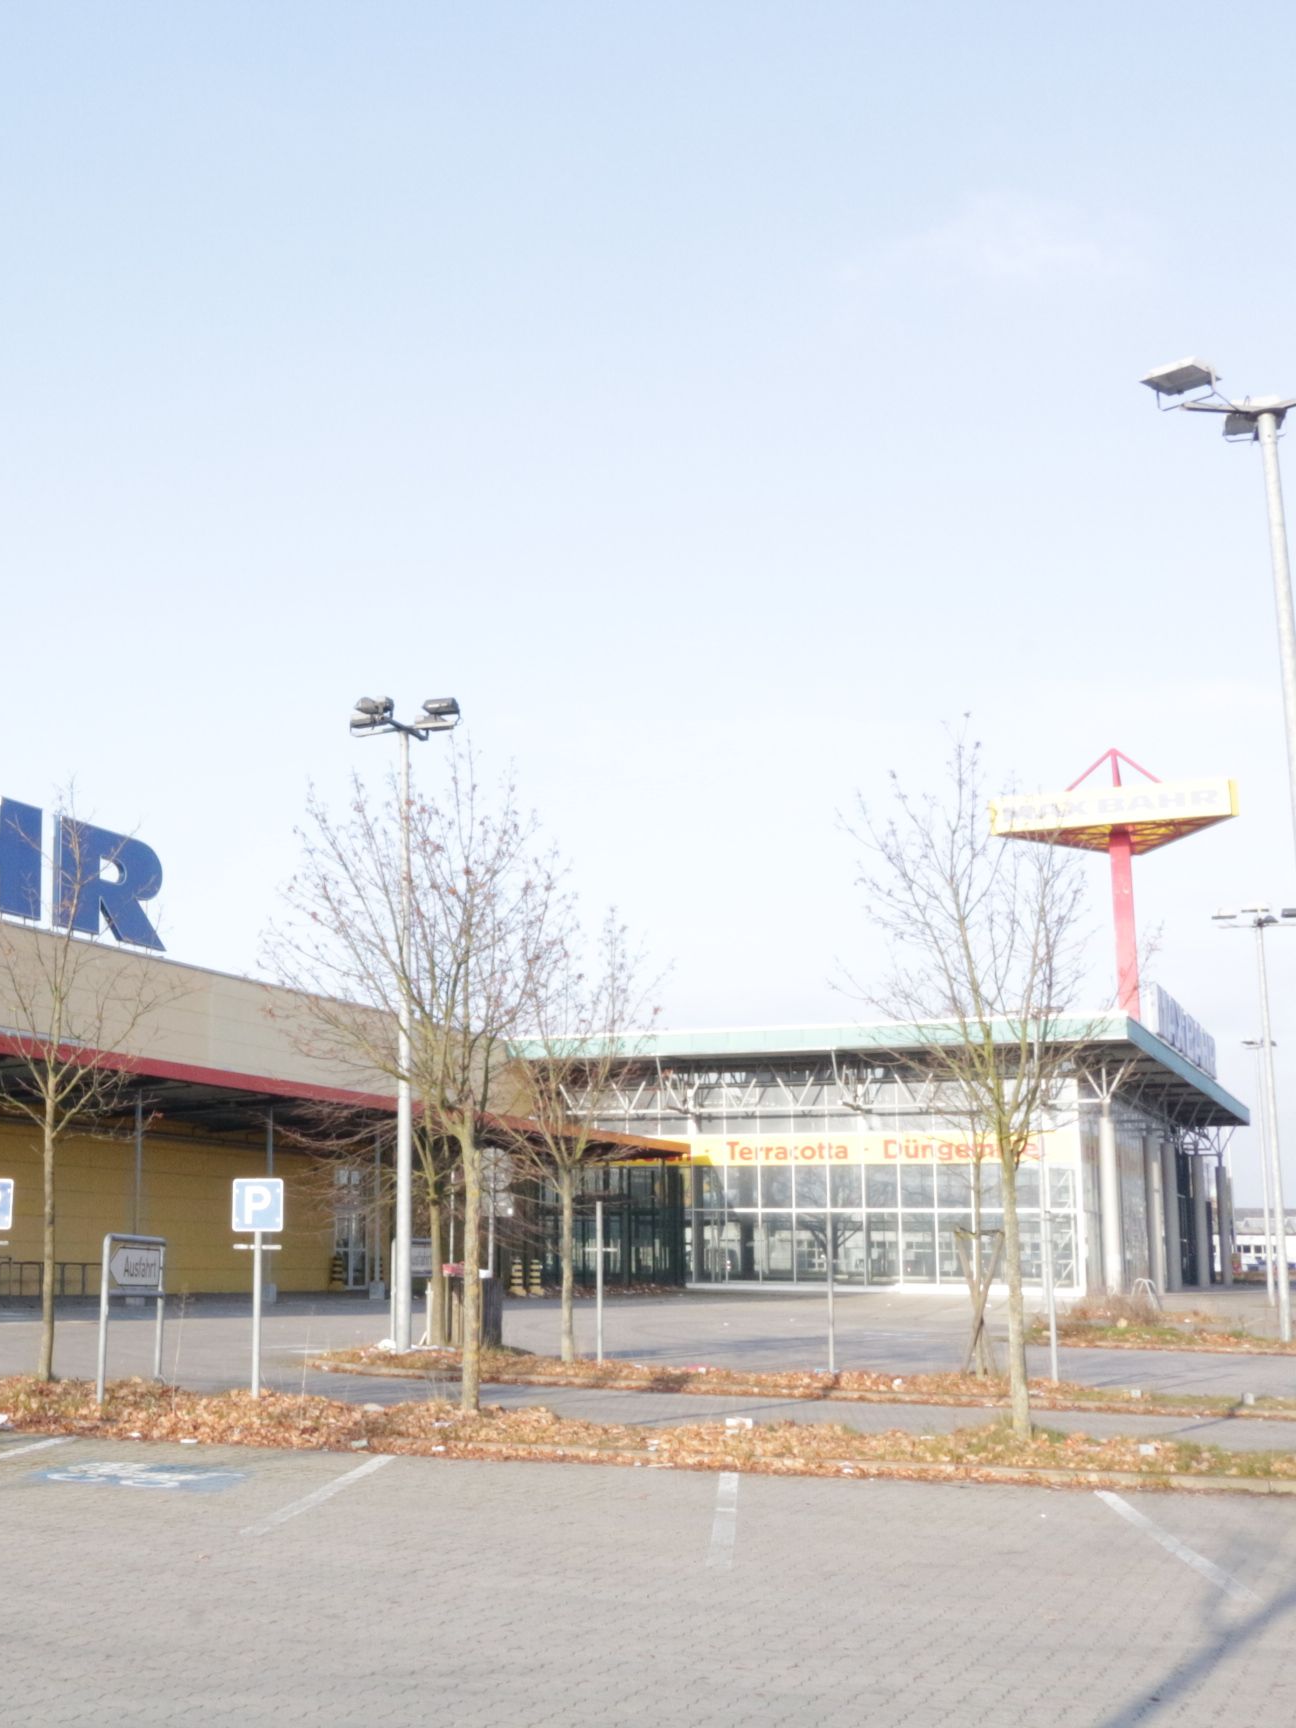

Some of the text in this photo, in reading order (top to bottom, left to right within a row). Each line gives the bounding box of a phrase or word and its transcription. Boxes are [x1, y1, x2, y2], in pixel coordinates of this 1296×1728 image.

[1097, 789, 1219, 814] BAHR
[726, 1140, 849, 1161] Terracotta
[243, 1184, 272, 1225] P
[123, 1254, 158, 1279] Ausfahrt
